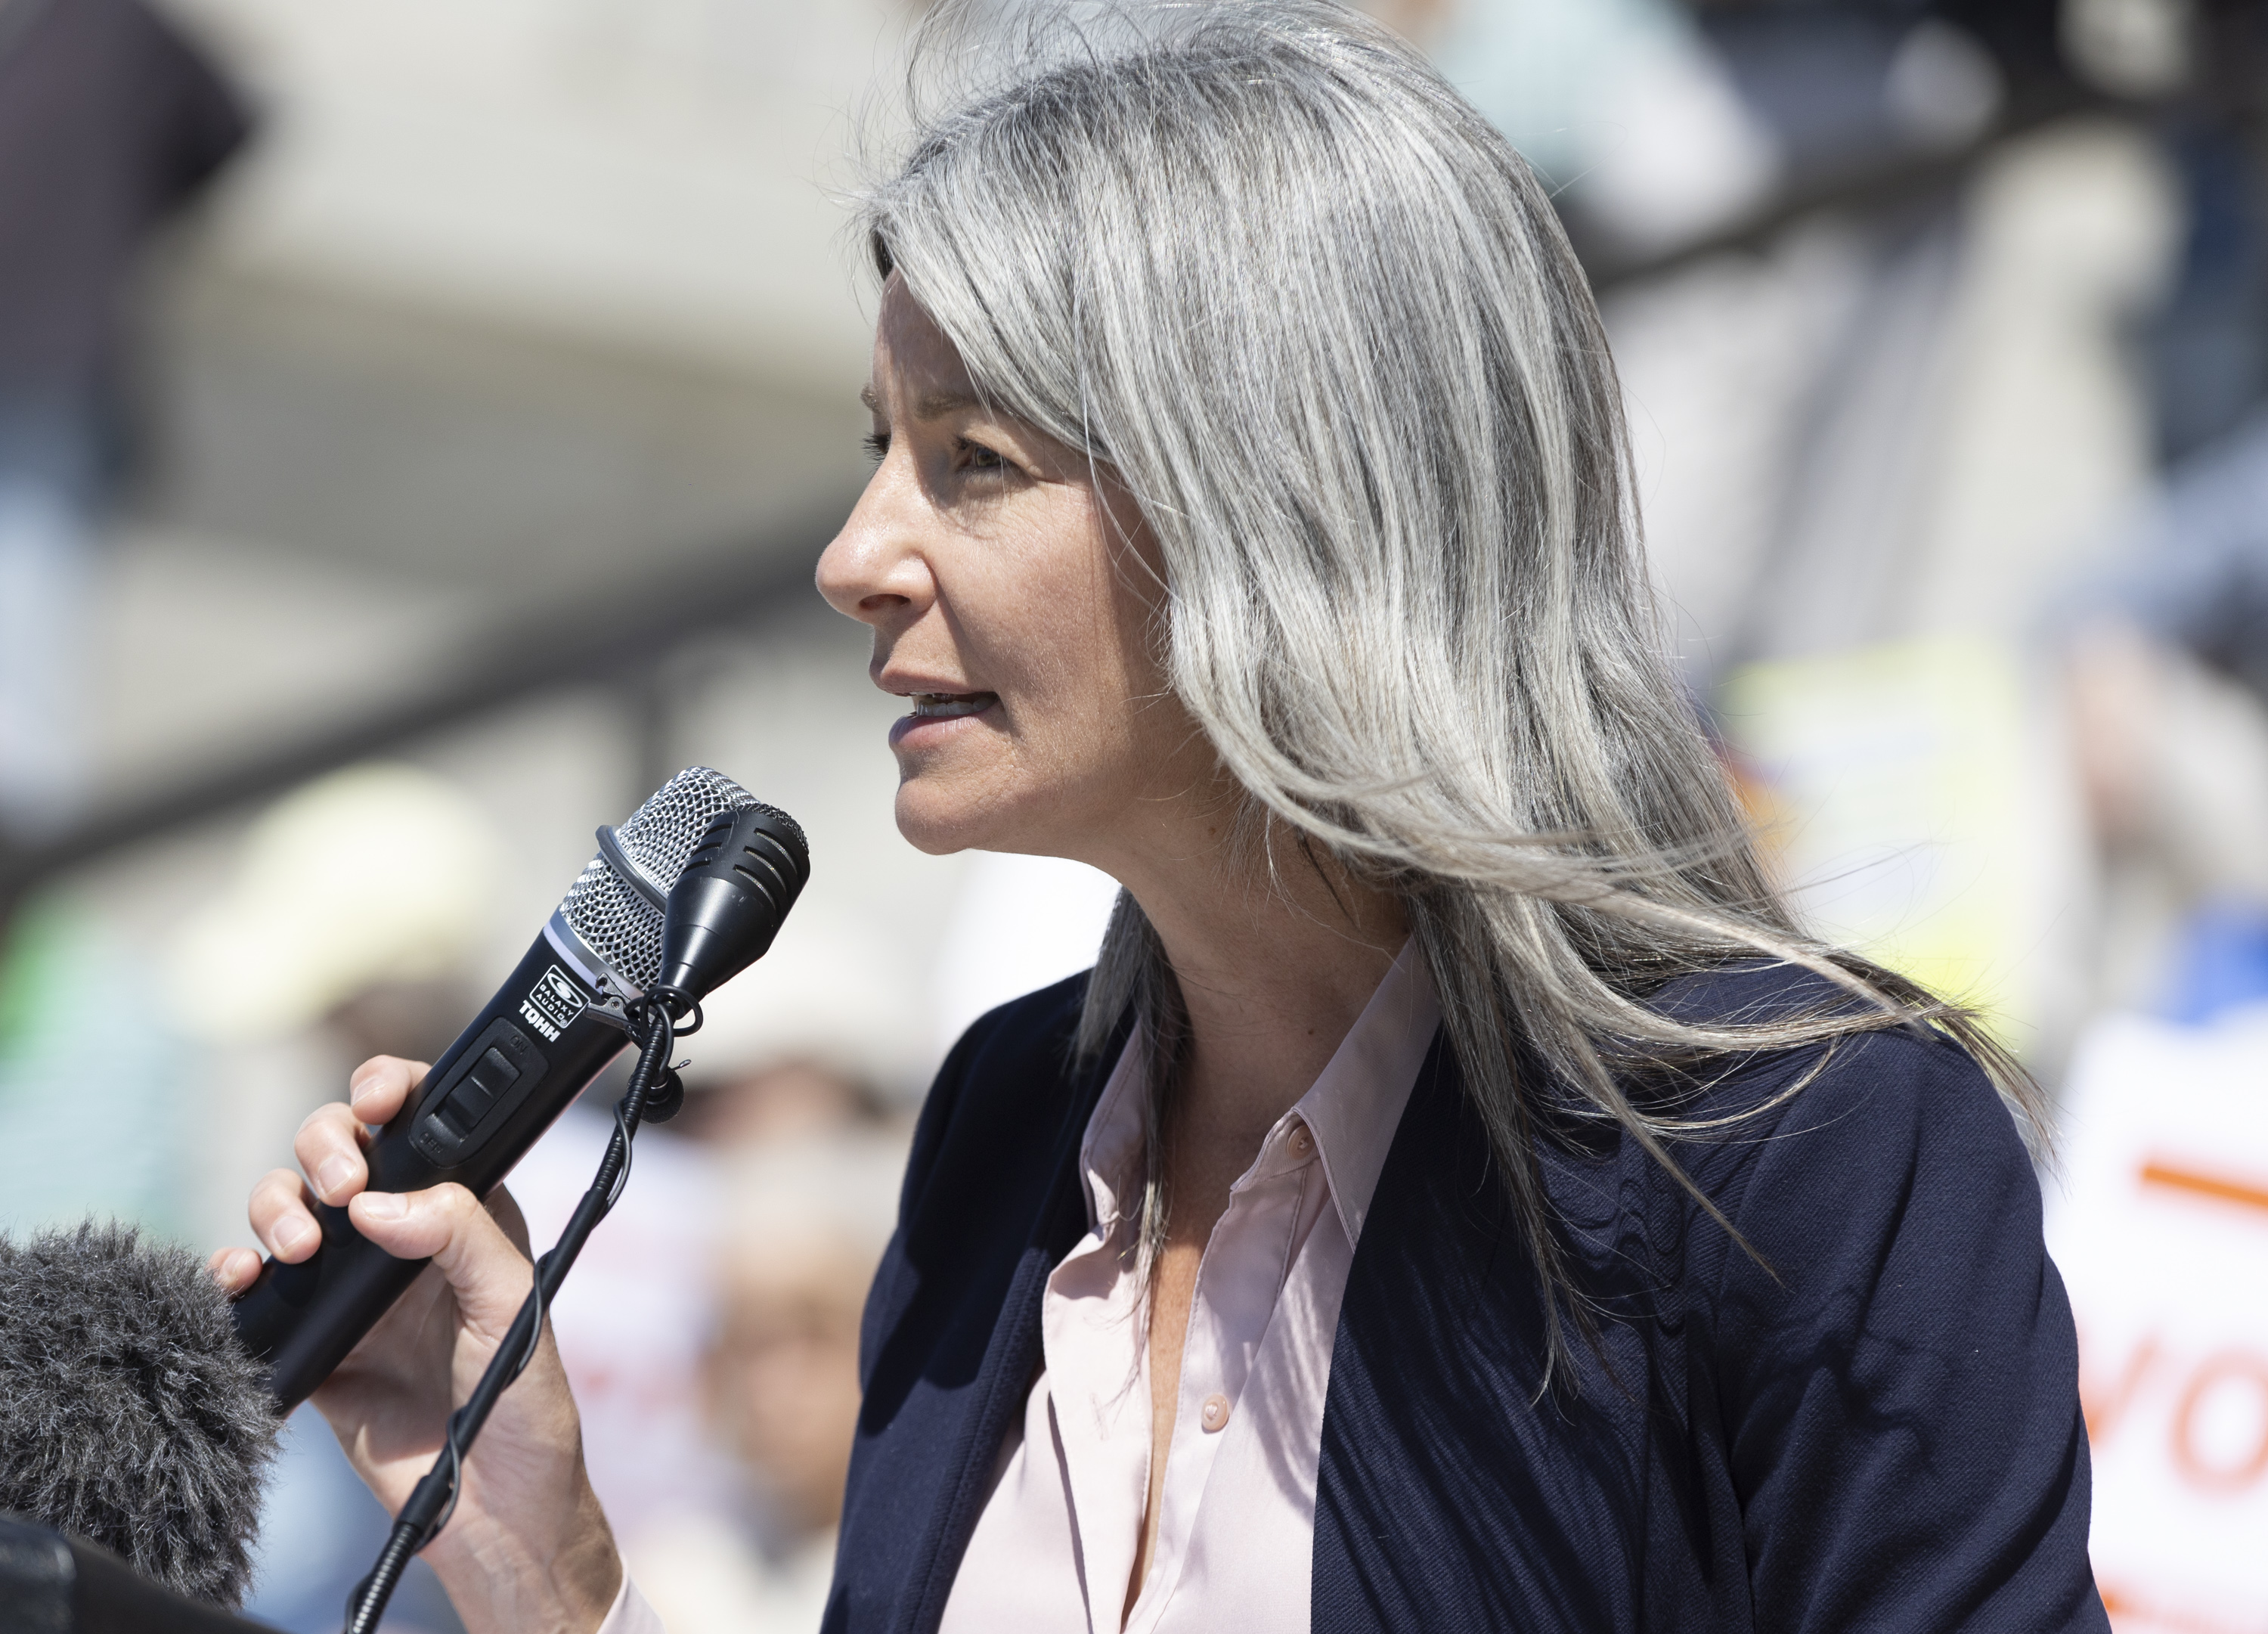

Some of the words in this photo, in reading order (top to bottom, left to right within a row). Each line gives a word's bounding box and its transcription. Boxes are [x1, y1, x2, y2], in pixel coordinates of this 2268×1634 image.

[535, 994, 565, 1020] AUDIO
[539, 984, 575, 1016] GALAXY
[519, 999, 561, 1043] TQHH
[509, 1035, 528, 1055] ON
